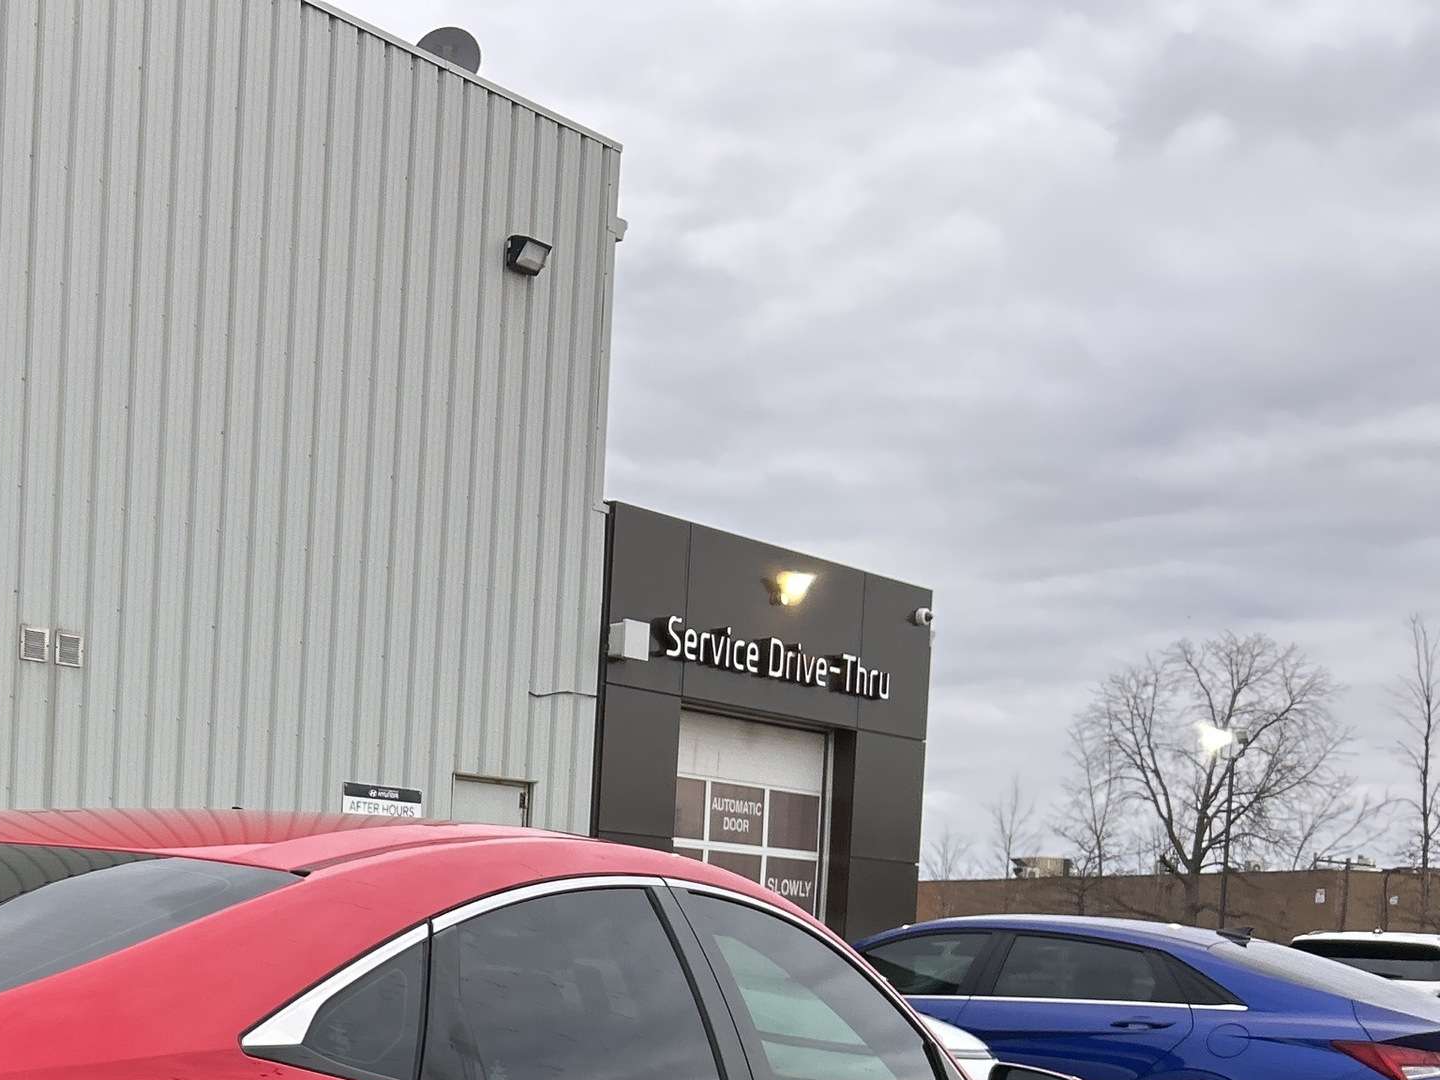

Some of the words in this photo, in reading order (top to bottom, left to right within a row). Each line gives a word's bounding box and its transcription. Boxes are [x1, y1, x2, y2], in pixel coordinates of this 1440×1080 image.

[666, 615, 759, 673] Service
[768, 637, 890, 700] Drive-Thru
[350, 800, 380, 814] AFTER
[382, 804, 415, 817] HOURS
[711, 797, 762, 816] AUTOMATIC
[723, 817, 750, 832] DOOR
[767, 877, 812, 897] SLOWLY
